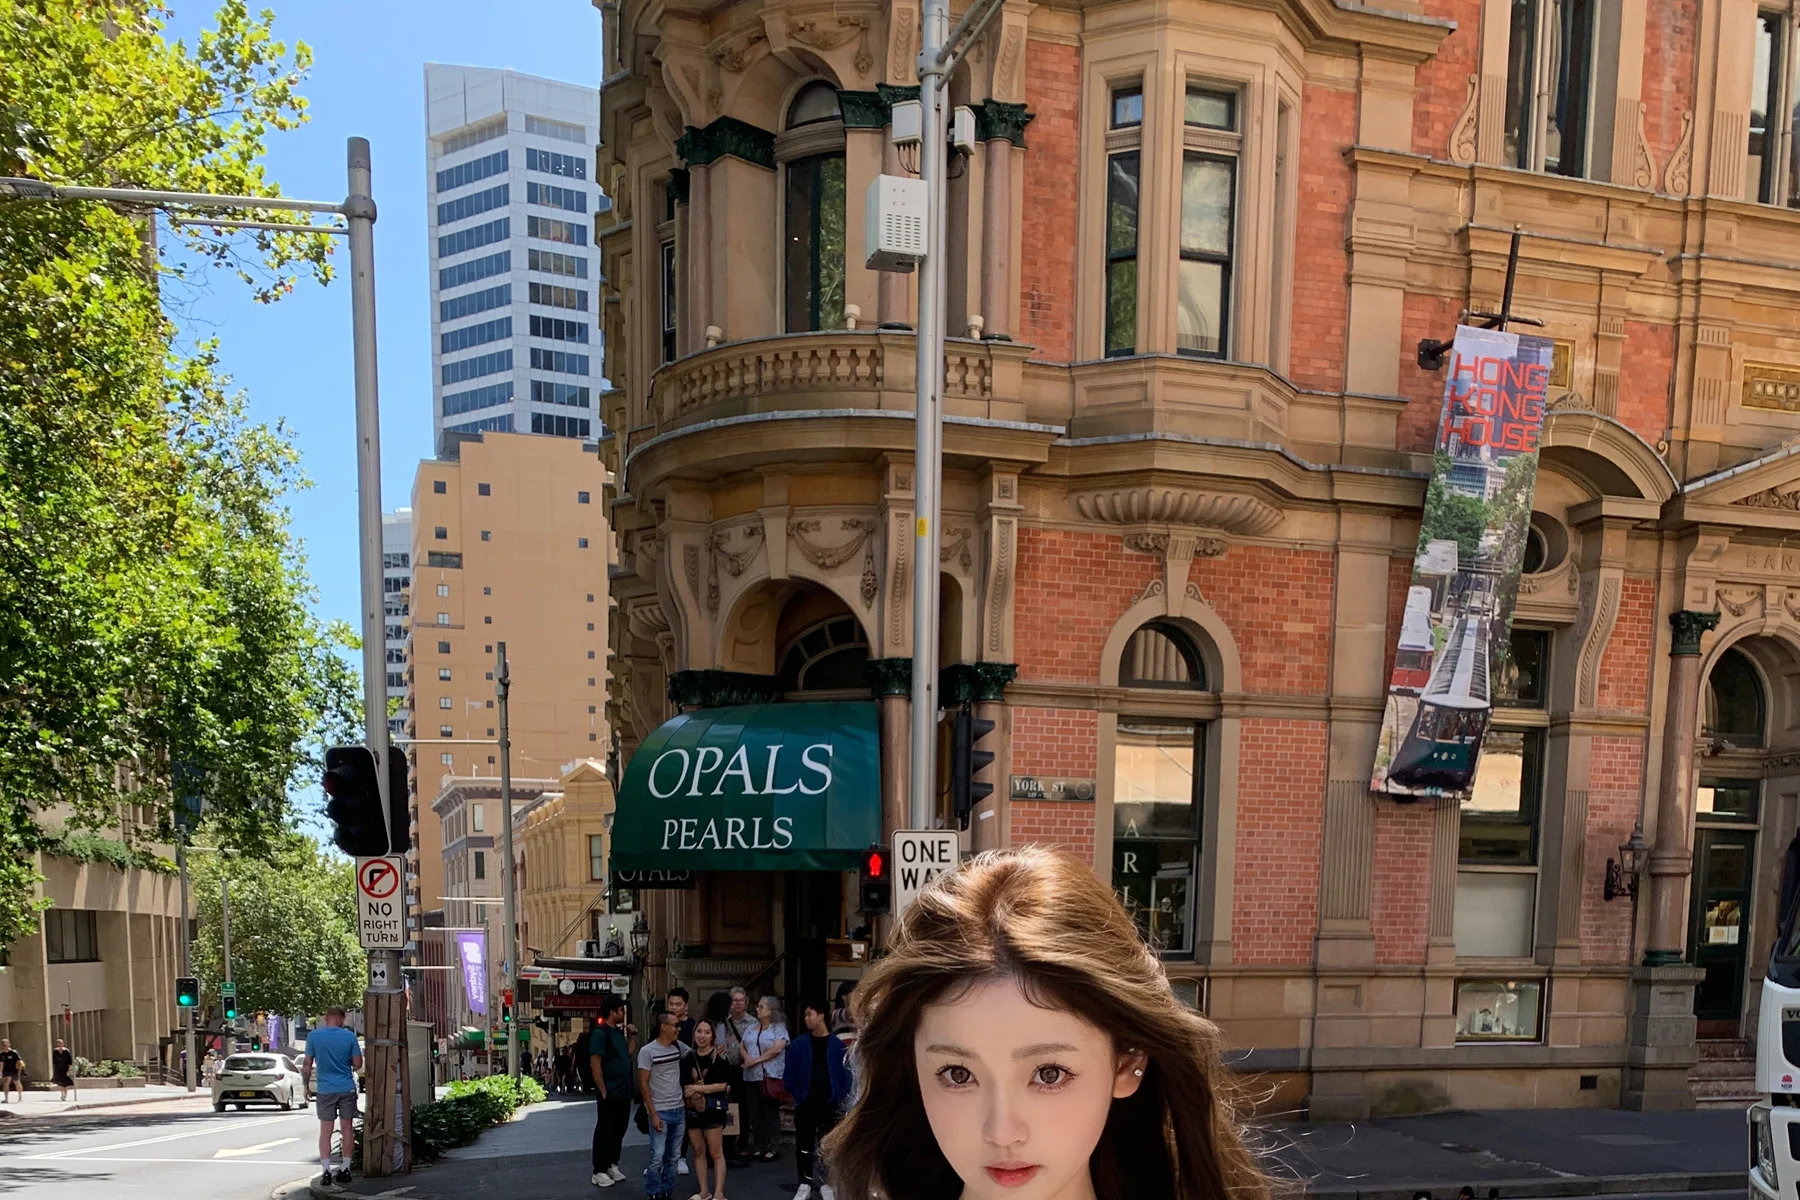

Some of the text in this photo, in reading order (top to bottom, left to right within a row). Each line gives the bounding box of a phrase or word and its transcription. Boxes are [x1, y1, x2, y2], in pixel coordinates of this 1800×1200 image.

[1453, 353, 1546, 392] HONG
[1448, 384, 1543, 422] KONG
[1441, 416, 1539, 453] HOUSE
[1746, 552, 1800, 571] BAN
[648, 744, 833, 799] OPALS
[1014, 780, 1066, 792] YORK ST
[661, 817, 793, 850] PEARLS
[902, 840, 951, 863] ONE
[368, 902, 392, 917] NO
[363, 920, 398, 929] RIGHT
[366, 933, 398, 943] TURN
